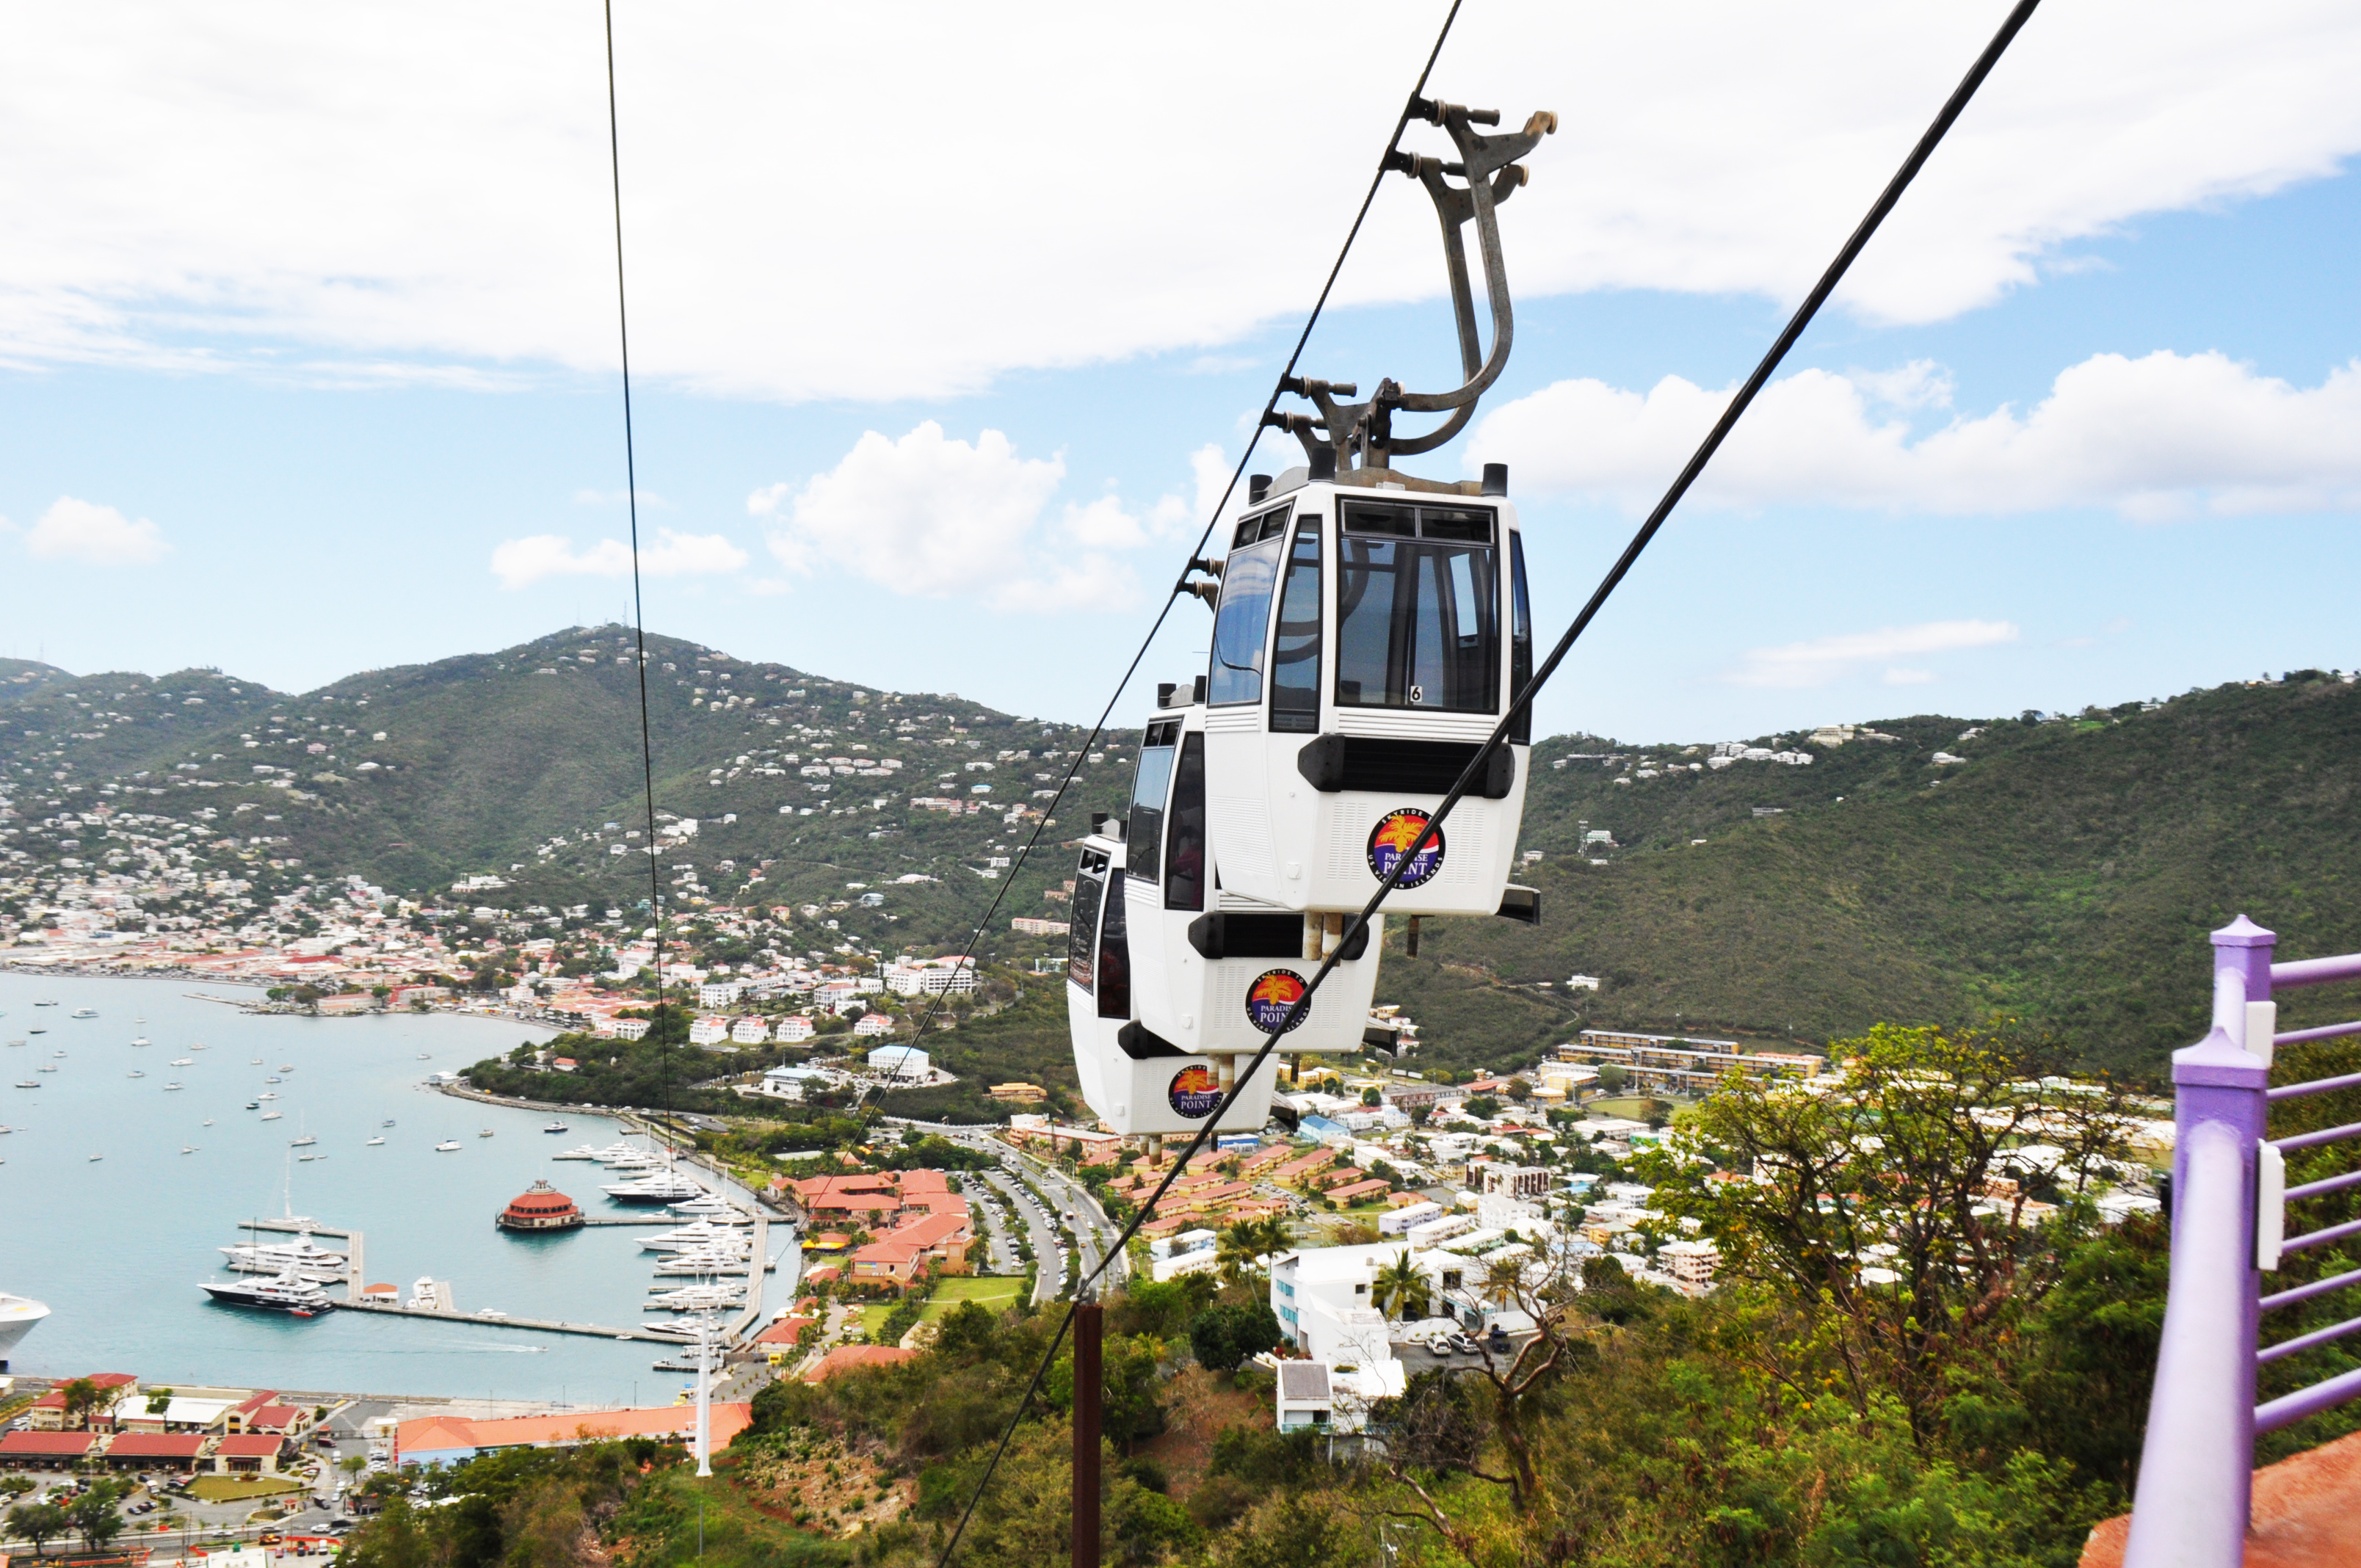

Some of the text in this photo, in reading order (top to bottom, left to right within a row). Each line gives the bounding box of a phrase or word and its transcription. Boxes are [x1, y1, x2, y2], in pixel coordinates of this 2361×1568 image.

[1412, 686, 1421, 701] 6
[1382, 809, 1423, 824] SKYRIDE
[1385, 852, 1429, 862] PARISE
[1368, 854, 1443, 888] US VIRIN ISLANDS
[1383, 862, 1428, 875] PNT
[1257, 970, 1304, 983] SKYRIDE TO
[1247, 1007, 1310, 1033] US VIRGI SLANDS
[1260, 1012, 1291, 1023] POIN
[1180, 1100, 1212, 1109] POINT
